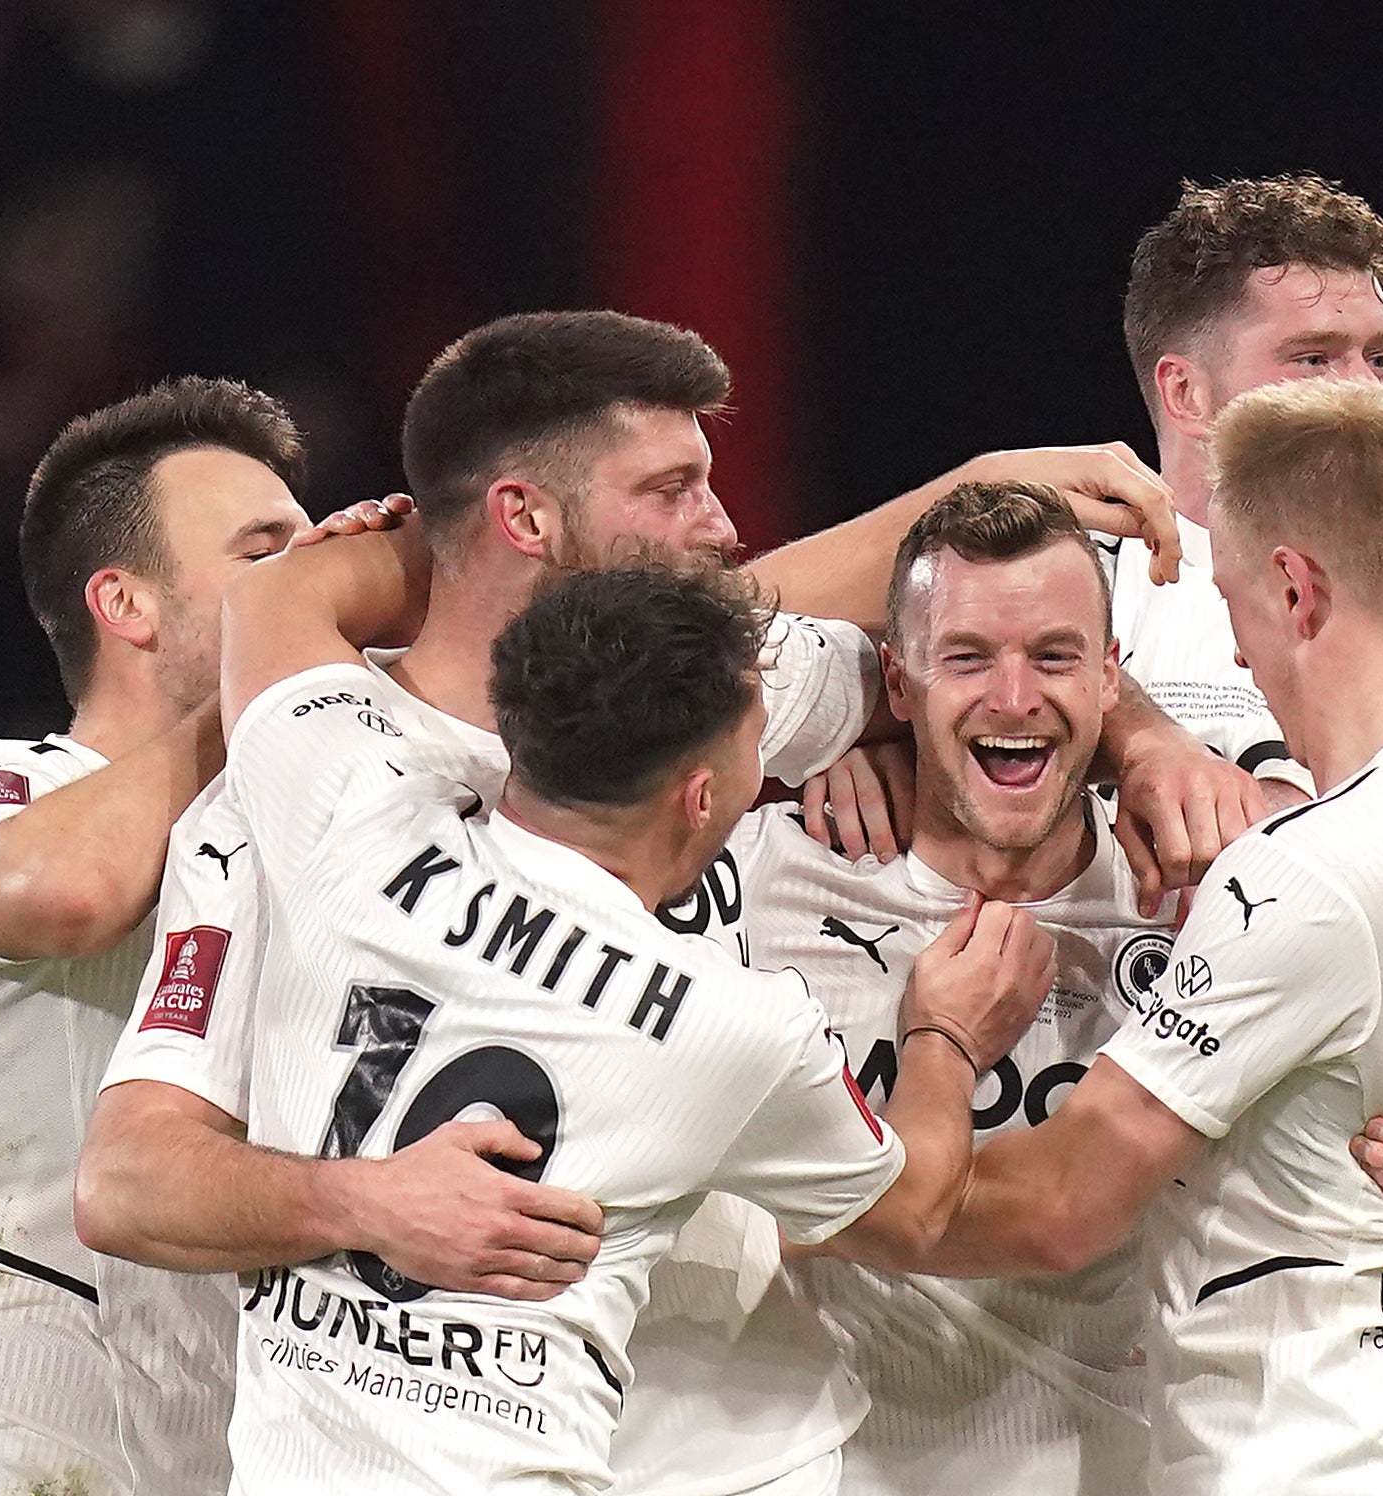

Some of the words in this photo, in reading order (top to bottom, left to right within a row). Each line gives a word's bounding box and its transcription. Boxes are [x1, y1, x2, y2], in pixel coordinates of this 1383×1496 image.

[380, 843, 462, 916] K
[441, 881, 695, 1043] SMITH
[166, 993, 204, 1012] CUP
[494, 1328, 548, 1368] FM
[343, 1361, 548, 1435] Management
